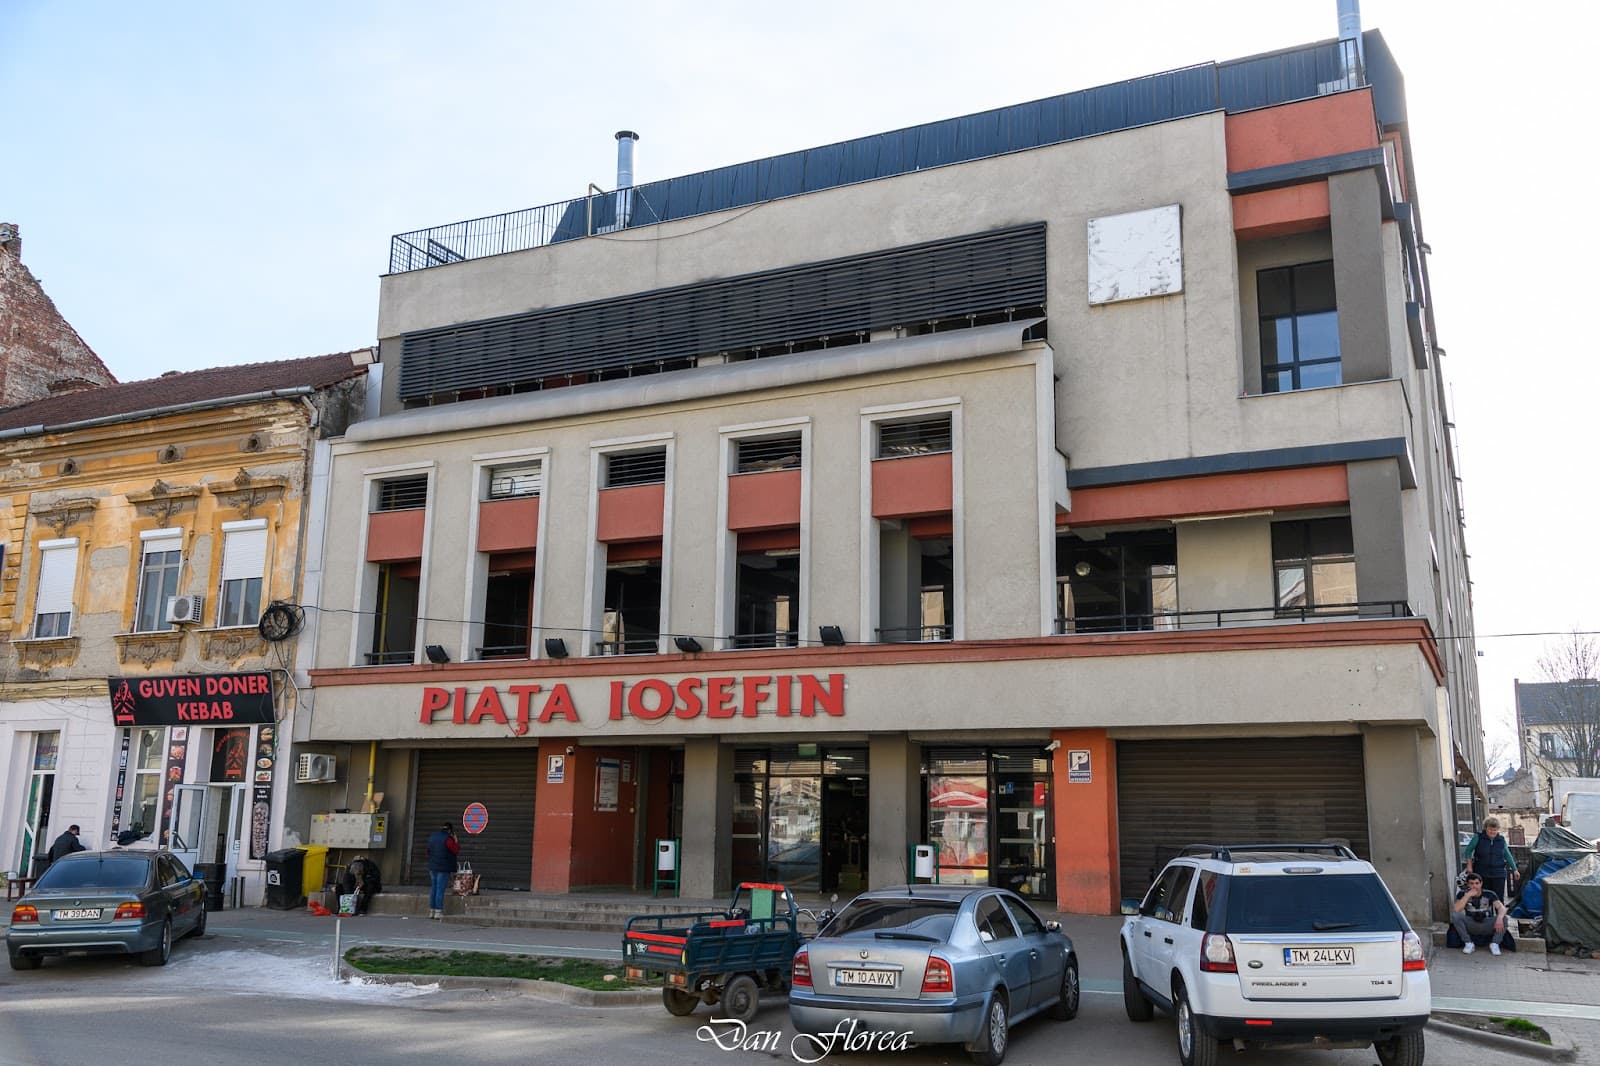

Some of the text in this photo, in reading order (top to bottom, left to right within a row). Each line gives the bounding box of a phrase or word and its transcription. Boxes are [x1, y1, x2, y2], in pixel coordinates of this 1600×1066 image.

[139, 675, 270, 698] GUVEN DONER
[610, 673, 846, 721] IOSEFIN
[176, 701, 234, 721] KEBAB
[59, 910, 68, 918] TM
[1292, 949, 1351, 962] TM 24LKV
[842, 971, 854, 982] TM
